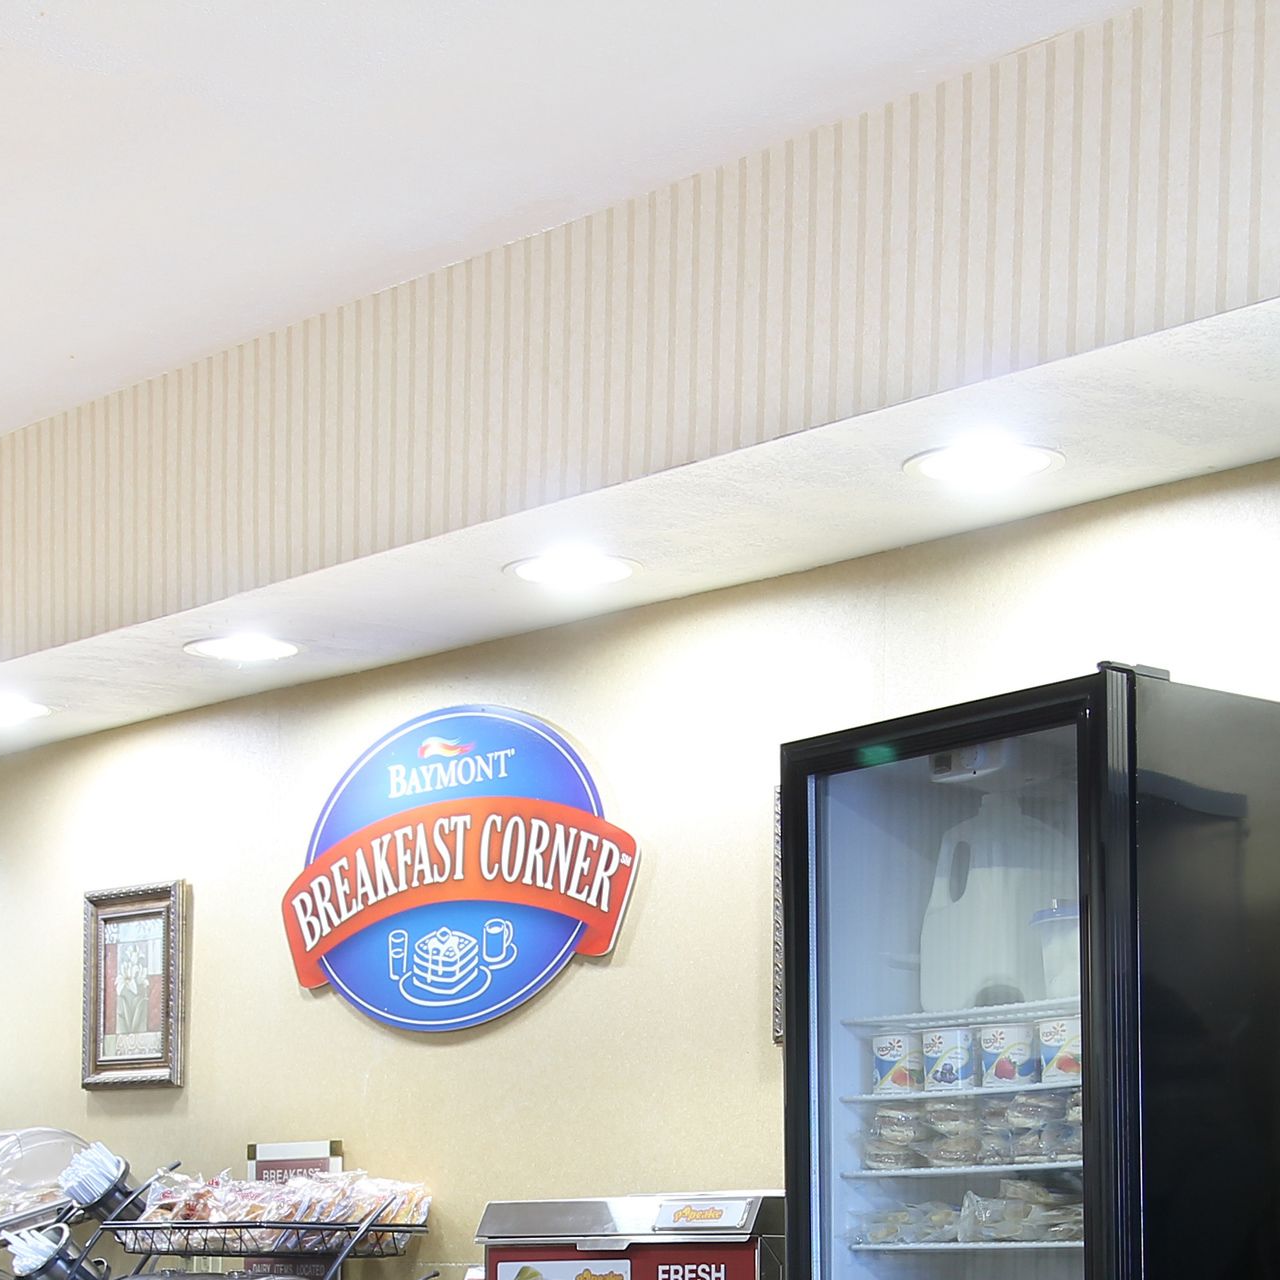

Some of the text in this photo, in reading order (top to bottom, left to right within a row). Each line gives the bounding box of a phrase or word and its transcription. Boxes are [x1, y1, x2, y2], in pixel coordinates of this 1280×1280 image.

[387, 751, 508, 799] BAYMONT
[290, 814, 471, 953] BREAKFAST
[480, 814, 621, 913] CORNER
[252, 1263, 325, 1276] DAIRY ITEMS LOCATED
